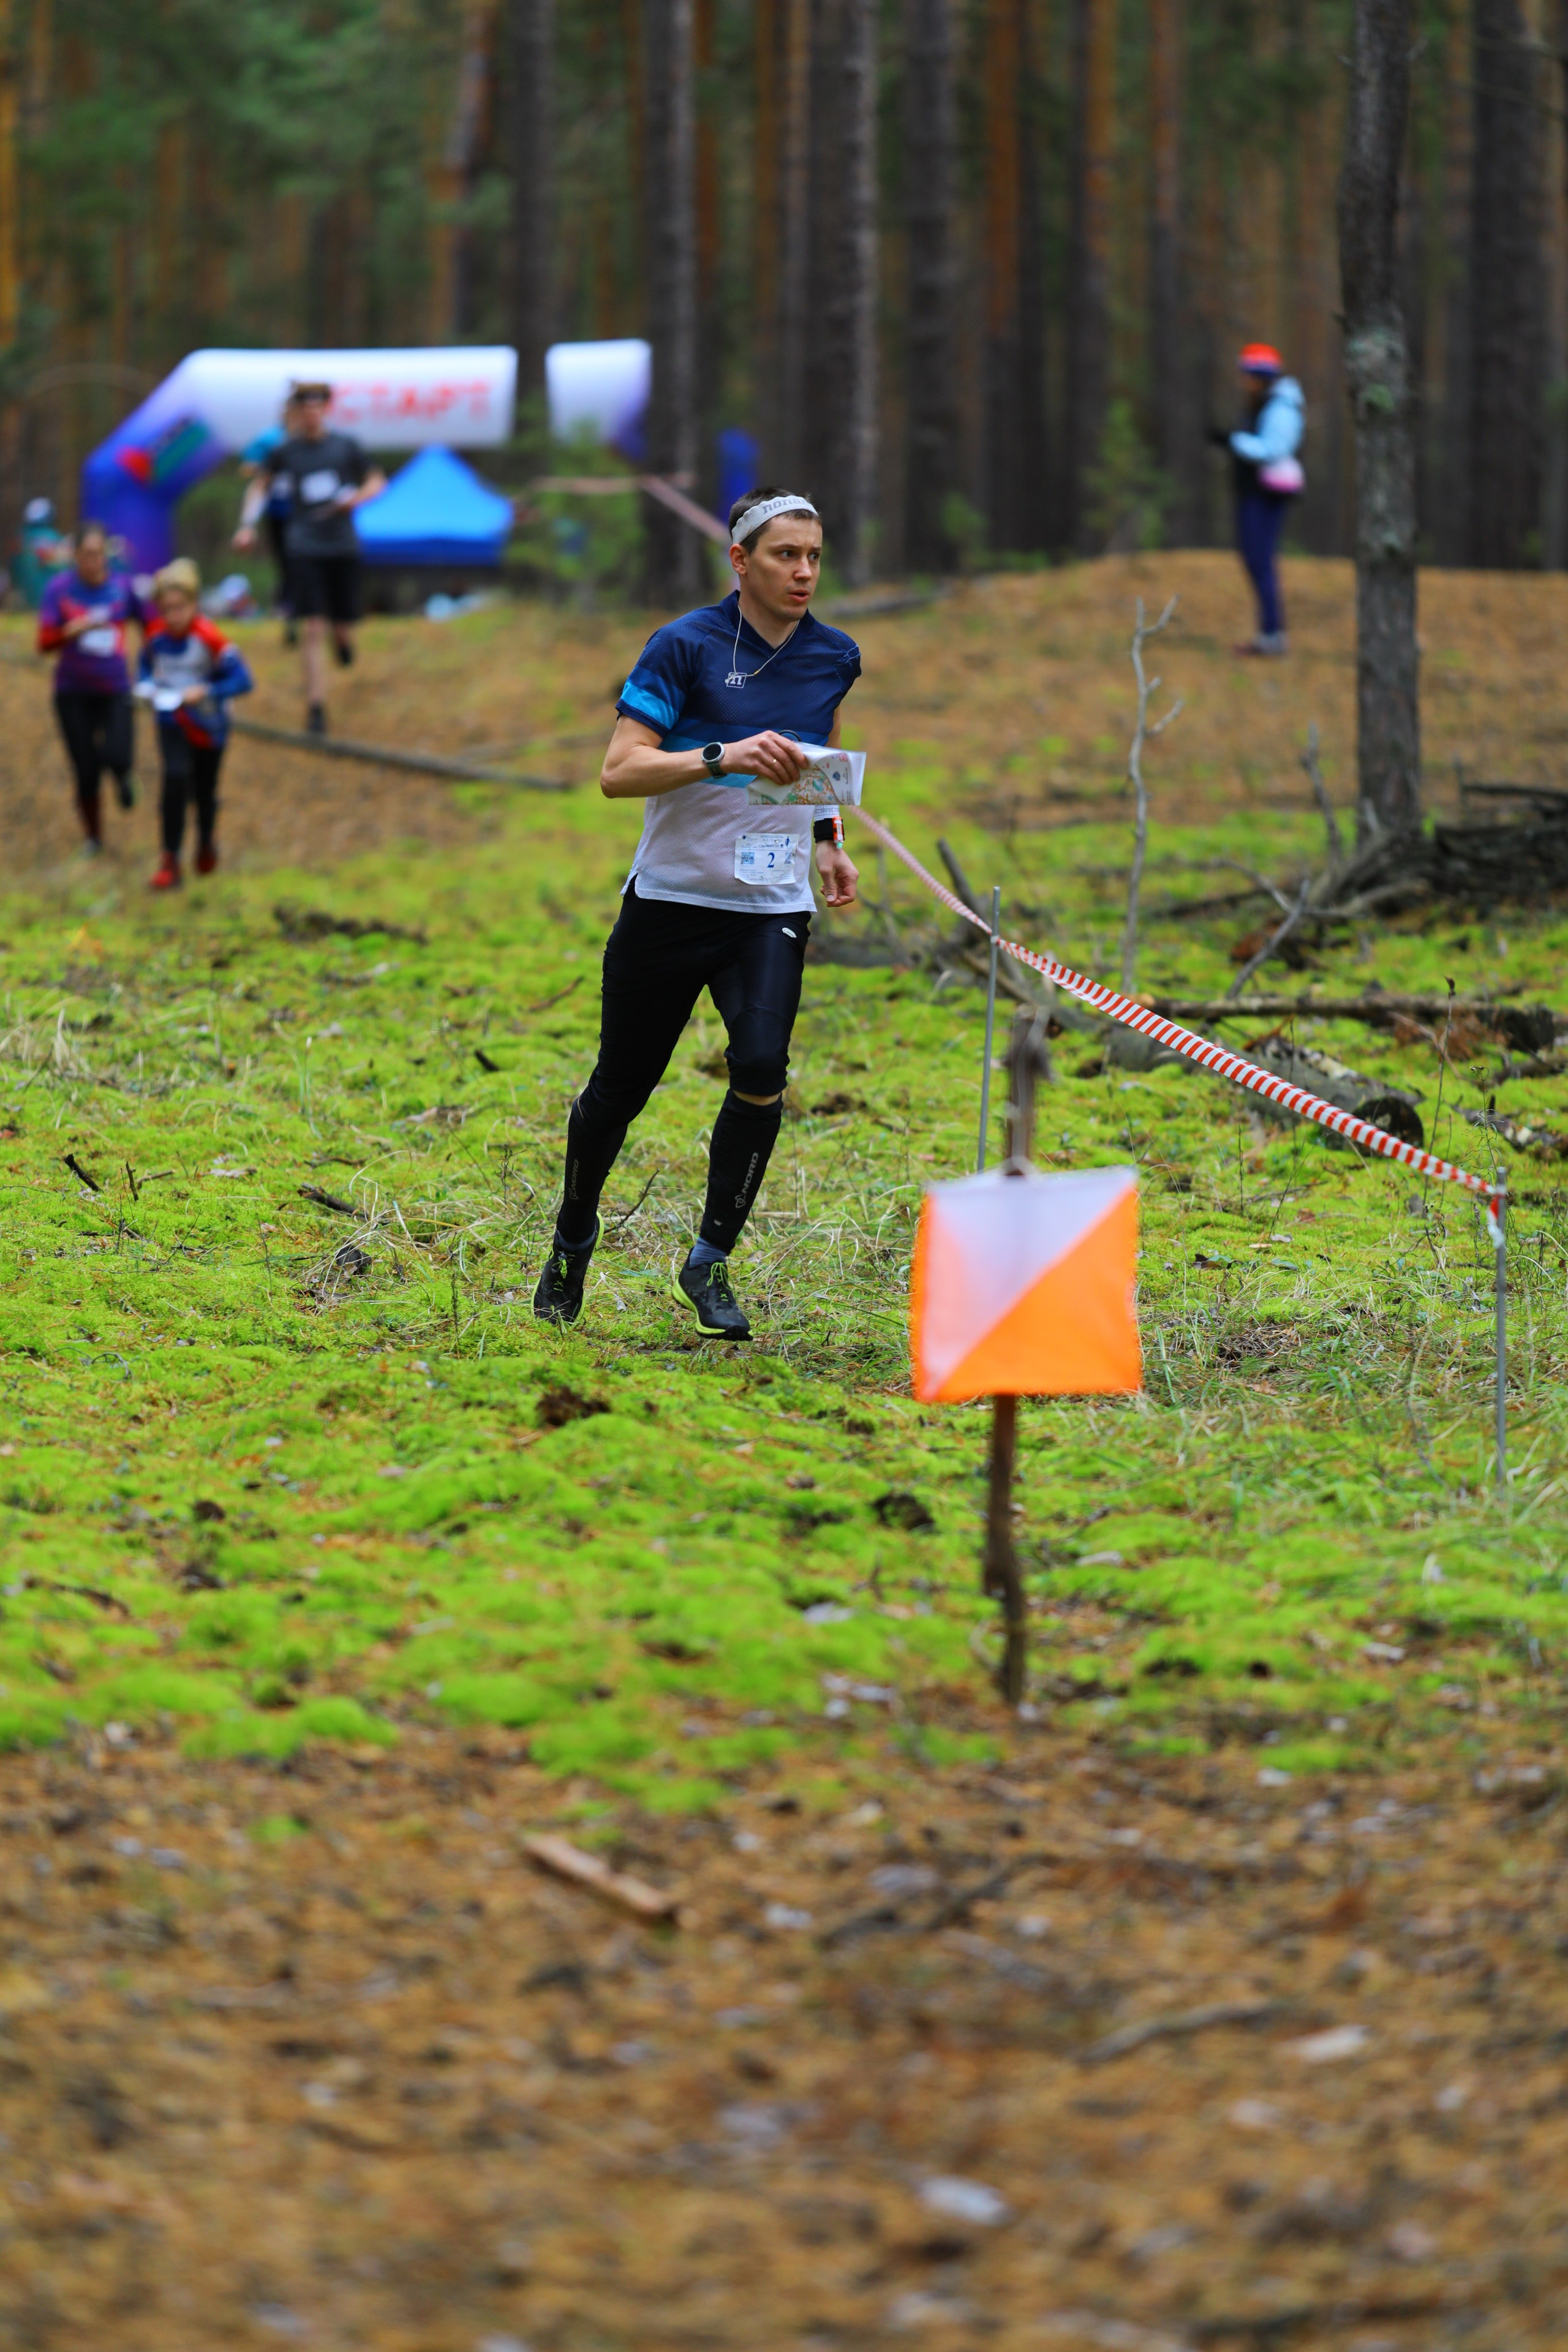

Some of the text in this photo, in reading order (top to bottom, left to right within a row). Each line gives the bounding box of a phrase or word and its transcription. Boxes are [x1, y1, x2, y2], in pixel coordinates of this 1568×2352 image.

[327, 380, 491, 423] СТАРТ
[767, 852, 775, 868] 2
[742, 1152, 758, 1194] NORD
